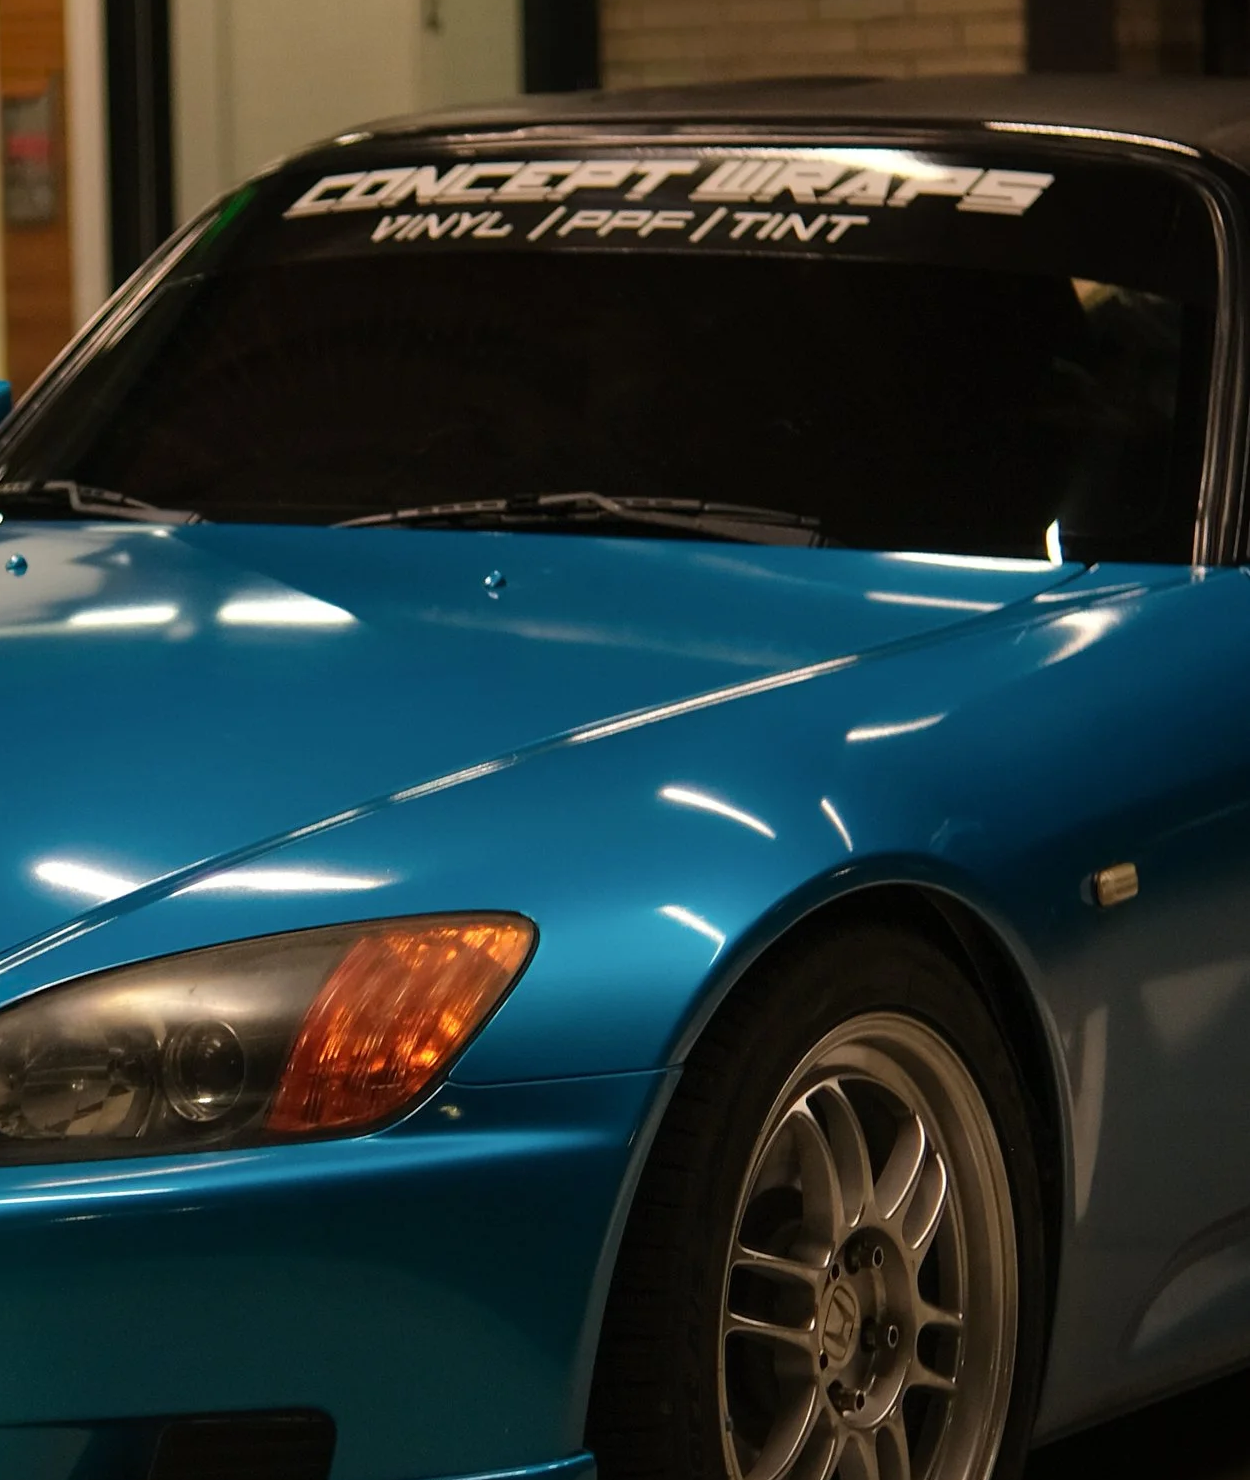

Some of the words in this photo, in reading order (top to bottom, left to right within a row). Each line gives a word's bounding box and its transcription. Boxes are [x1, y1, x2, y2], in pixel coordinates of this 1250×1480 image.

[283, 159, 701, 218] CONCEPT
[688, 159, 1055, 216] WRAPS
[371, 210, 514, 243] VINYL
